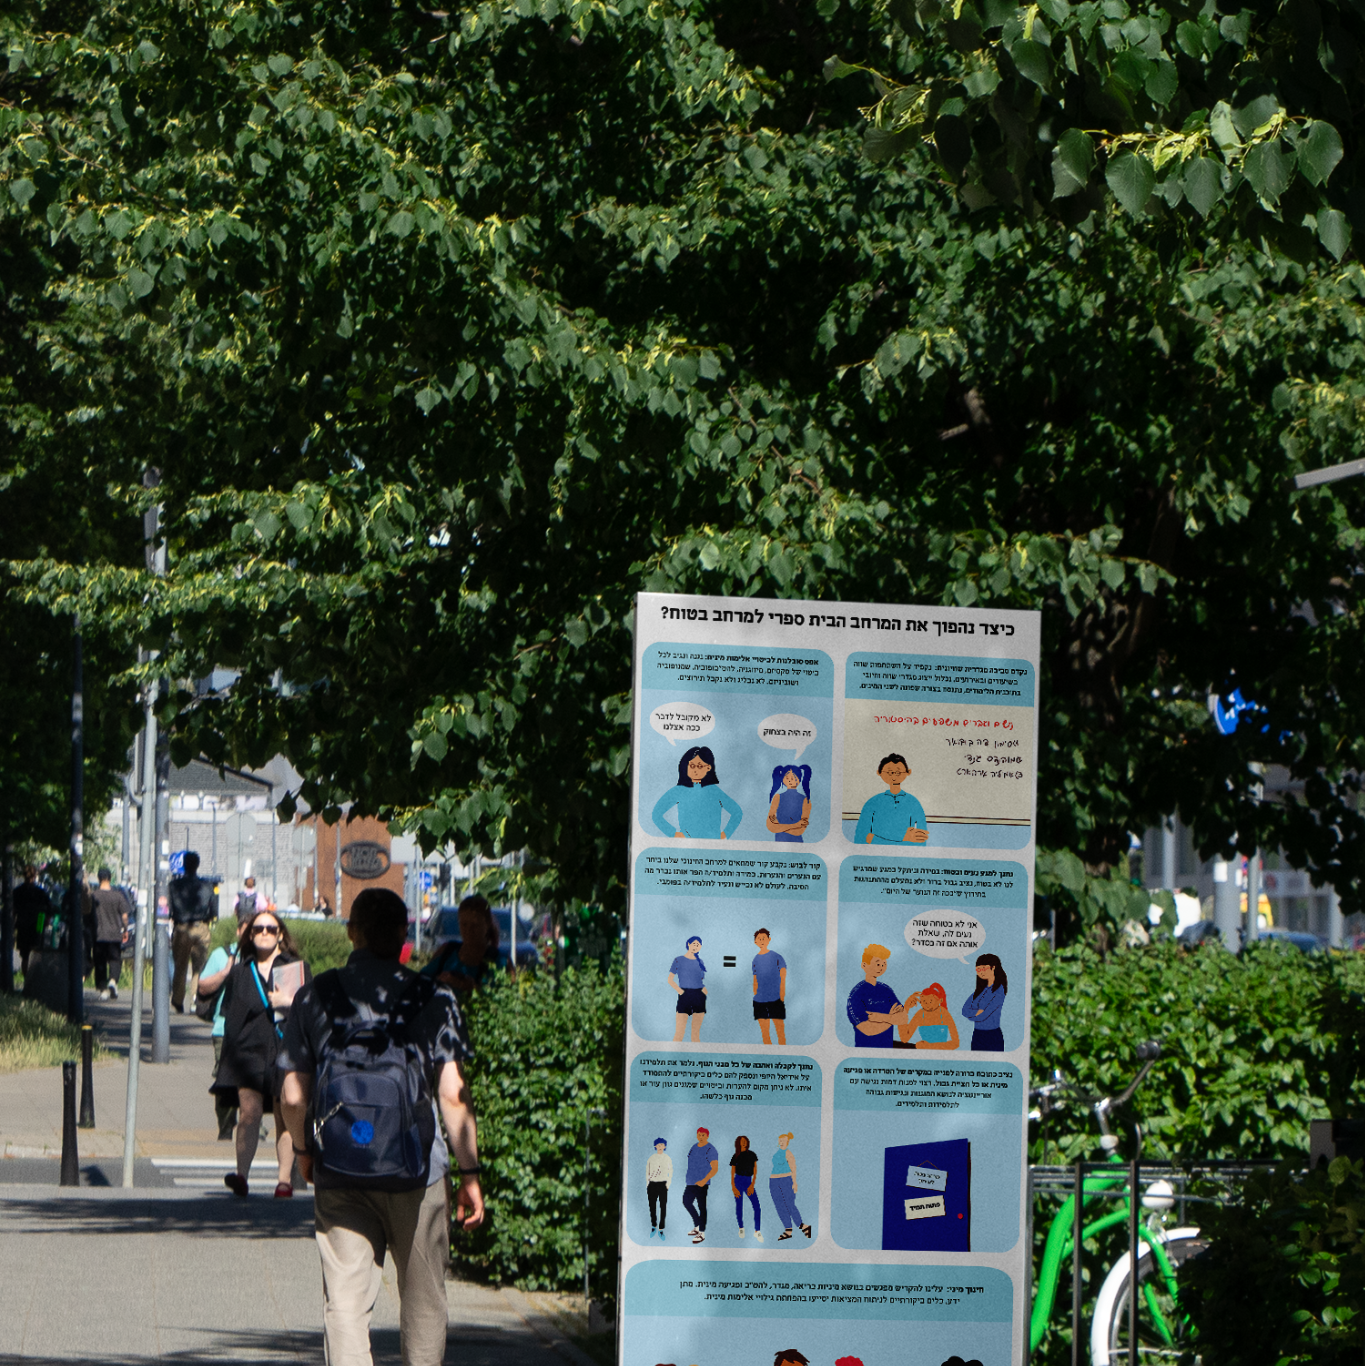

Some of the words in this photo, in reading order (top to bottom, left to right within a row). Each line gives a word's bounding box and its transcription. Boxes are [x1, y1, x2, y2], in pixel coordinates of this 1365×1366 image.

[661, 606, 708, 621] בטוח?
[712, 609, 764, 623] למרחב
[768, 612, 805, 625] ספרי
[808, 614, 846, 627] הבית
[849, 616, 901, 630] המרחב
[905, 619, 928, 632] את
[932, 620, 975, 635] נהפוך
[978, 622, 1014, 636] כיצד
